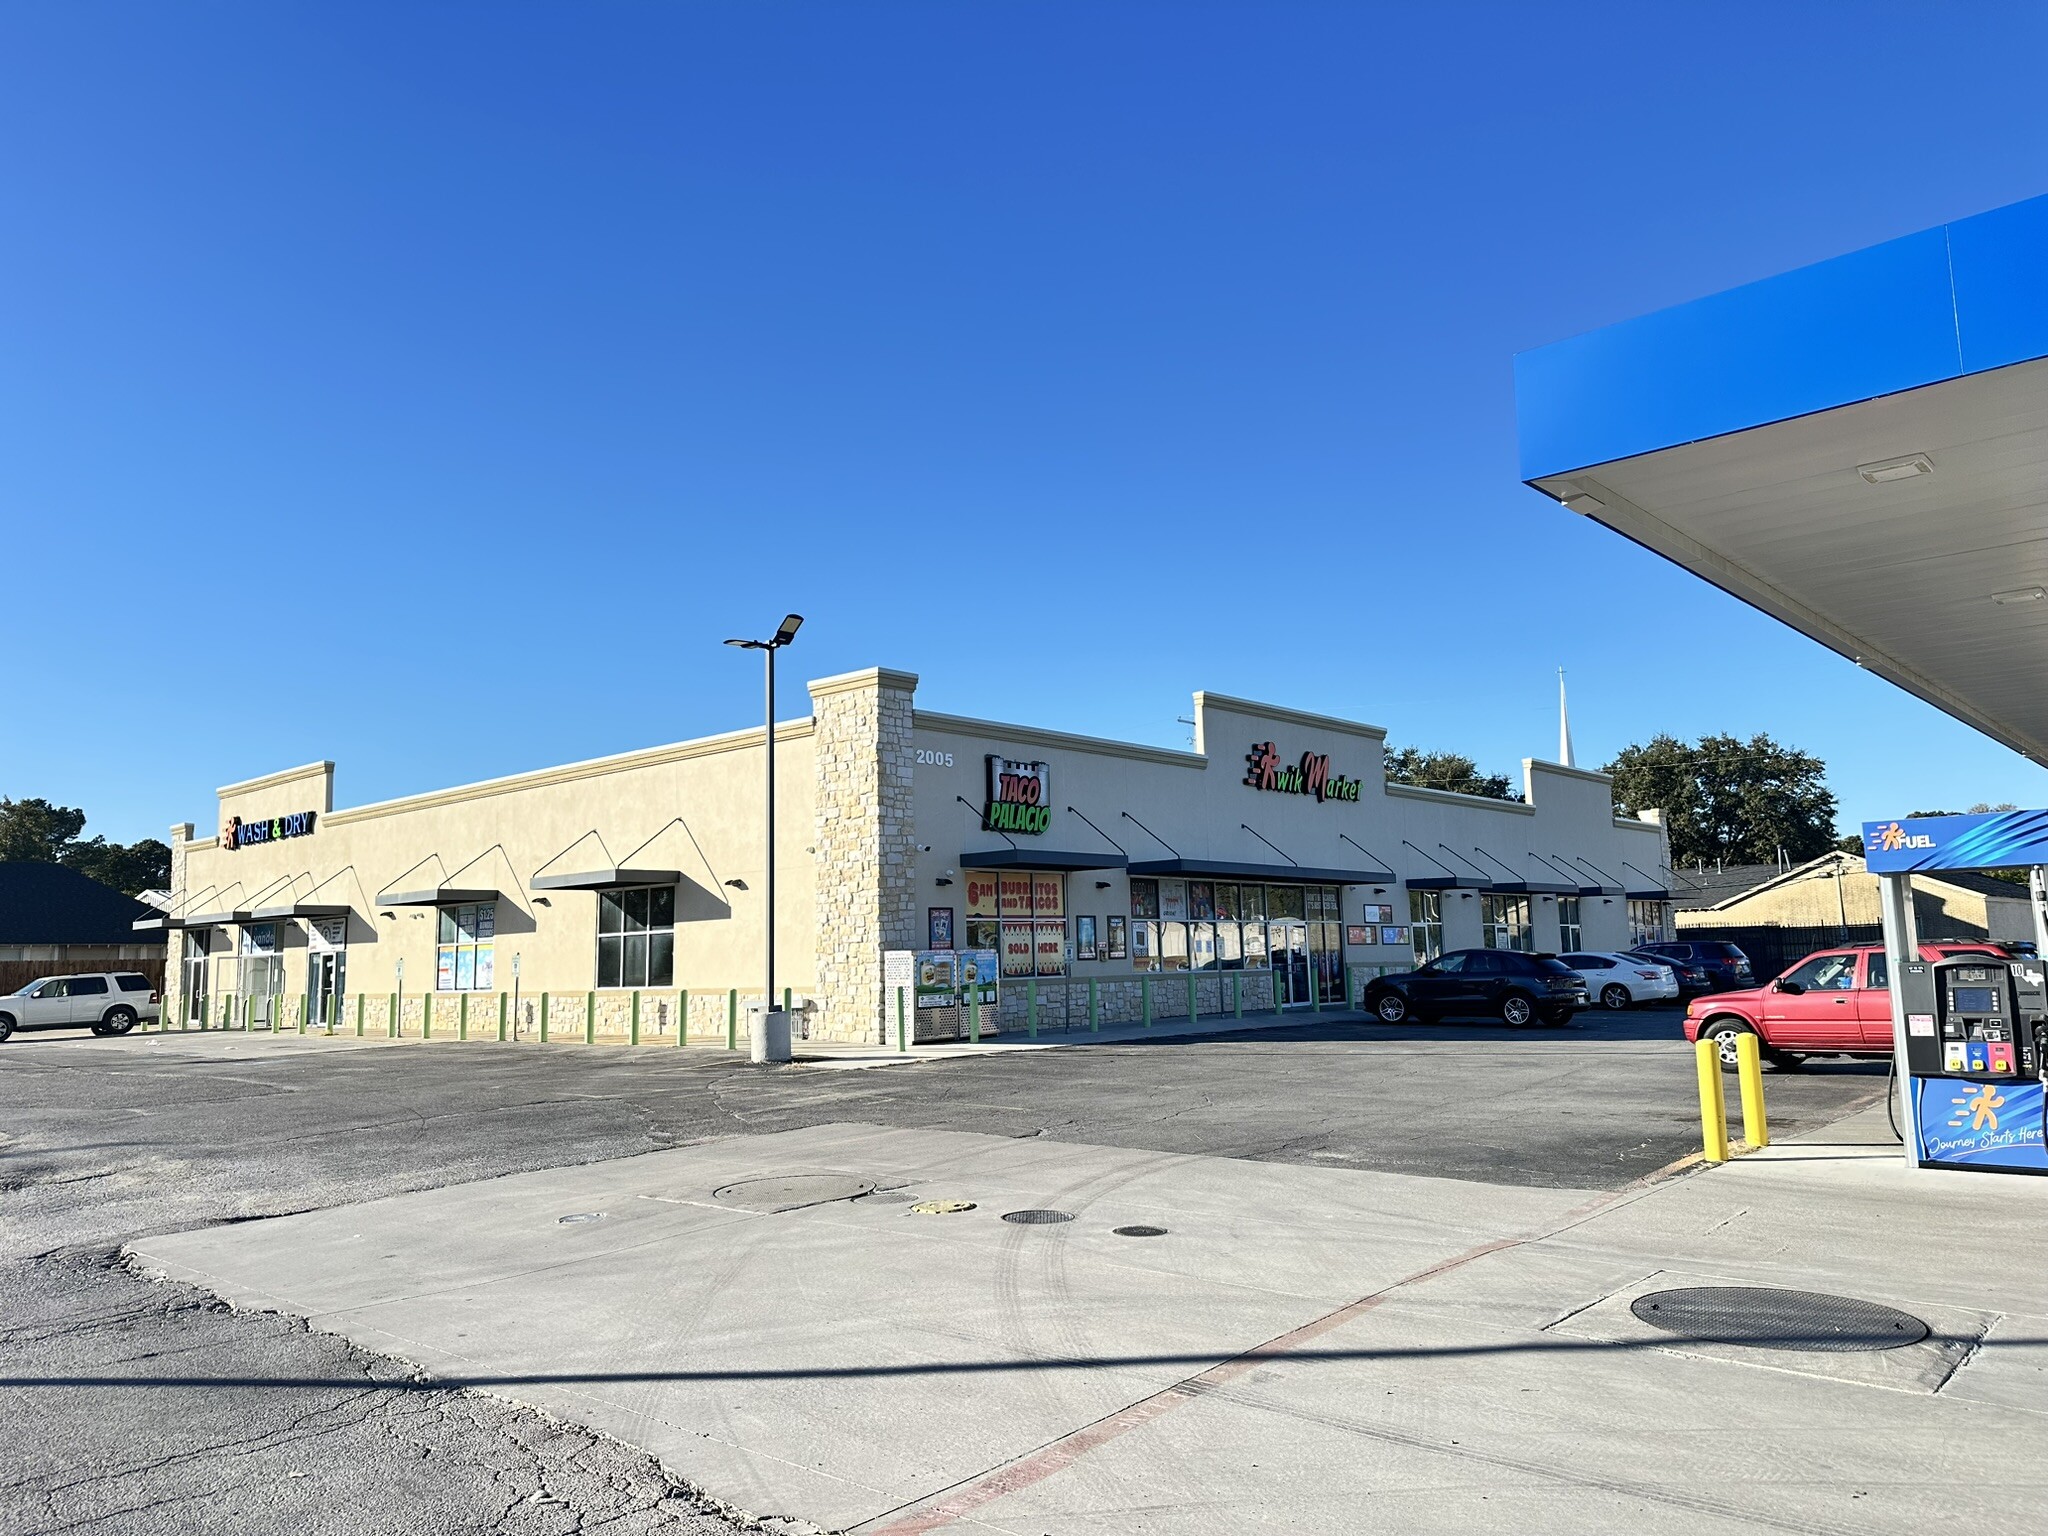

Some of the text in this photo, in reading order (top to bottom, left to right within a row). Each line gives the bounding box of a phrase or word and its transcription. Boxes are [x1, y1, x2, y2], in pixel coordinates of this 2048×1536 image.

[916, 749, 954, 767] 2005
[1000, 775, 1040, 804] TACO
[1304, 752, 1364, 800] Market
[238, 812, 309, 844] WASH & DRY
[990, 802, 1051, 832] PALACIO
[1897, 833, 1936, 849] FUEL
[1008, 943, 1029, 955] SOLD
[1038, 943, 1058, 954] HERE
[2012, 965, 2023, 976] 10
[1930, 1126, 2044, 1154] Journey Starts Here
